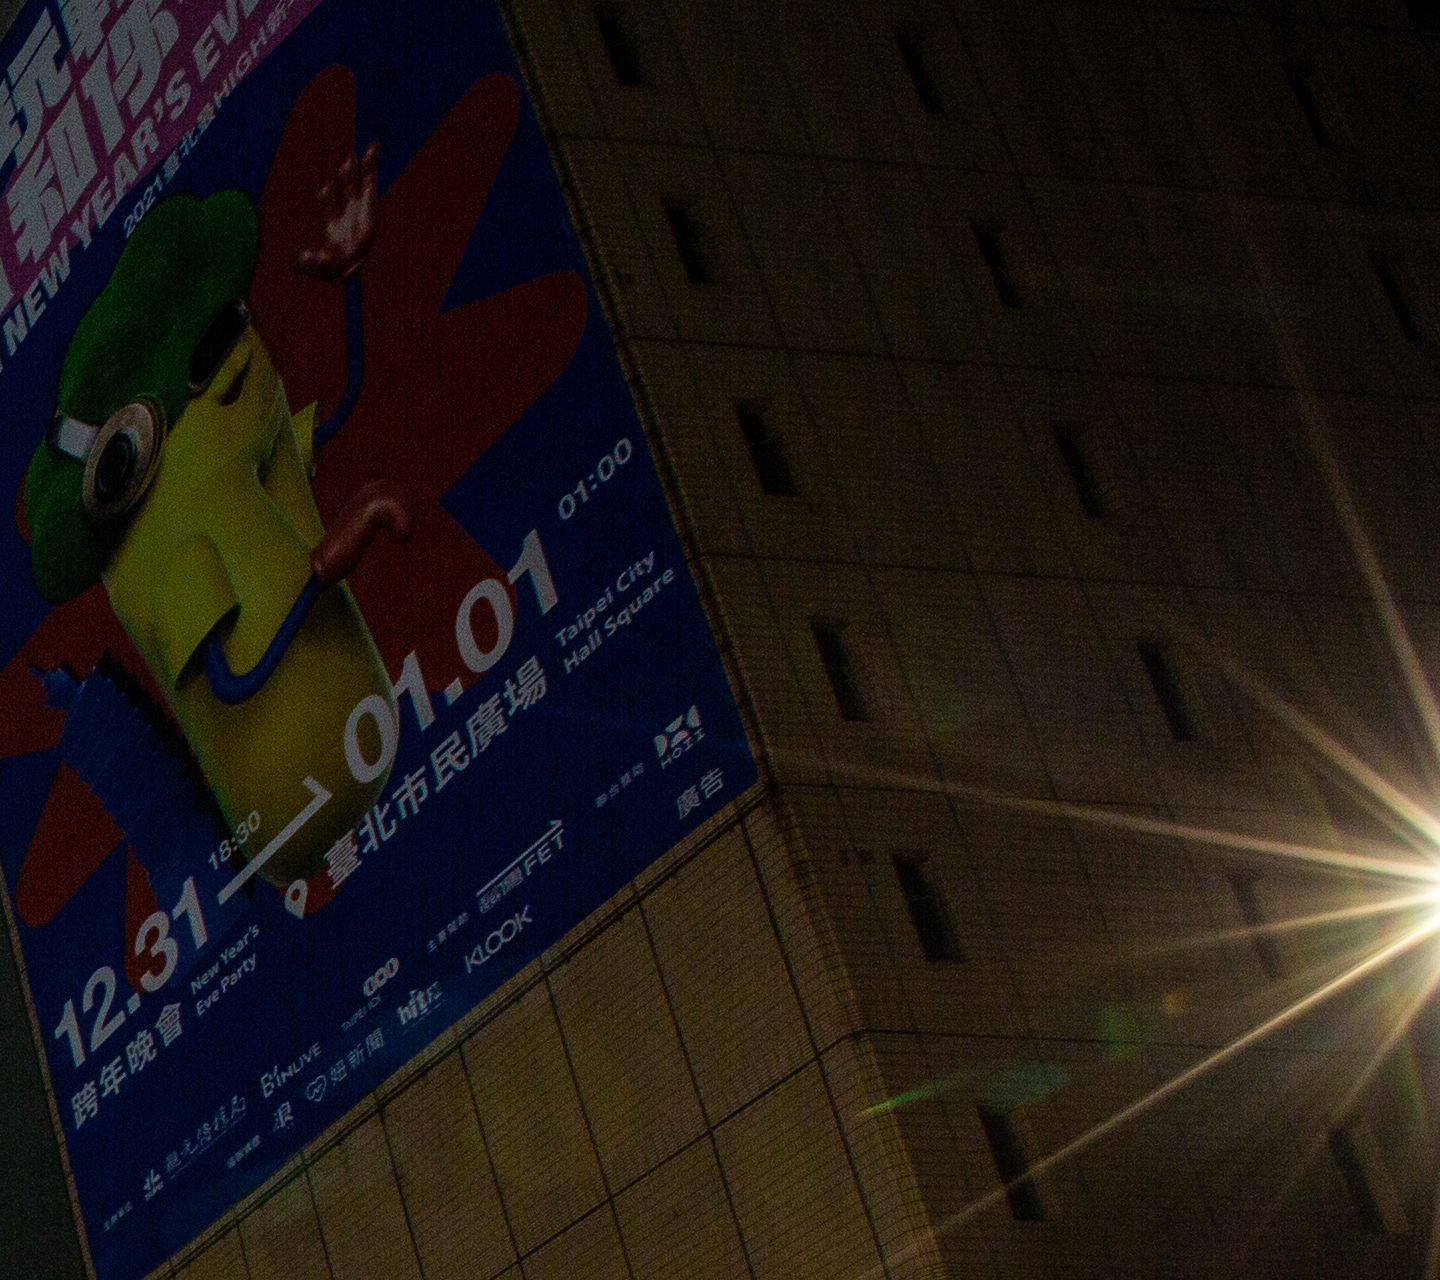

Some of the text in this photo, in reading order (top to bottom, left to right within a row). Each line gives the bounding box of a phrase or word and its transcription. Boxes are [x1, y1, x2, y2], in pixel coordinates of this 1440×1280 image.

[2, 248, 74, 359] NEW
[557, 437, 633, 521] 01:00
[553, 551, 655, 648] Taipei City
[562, 567, 676, 675] Hall Square
[343, 528, 559, 784] 01.01
[323, 655, 549, 891] 臺北市民廣場
[675, 767, 725, 820] 廣告
[208, 811, 262, 871] 18:30
[523, 828, 565, 876] FET
[54, 875, 209, 1069] 12.31
[190, 924, 261, 996] New Year's
[464, 904, 533, 974] KLOOK
[194, 953, 257, 1018] Eve Party
[70, 1001, 183, 1130] 跨年晚會
